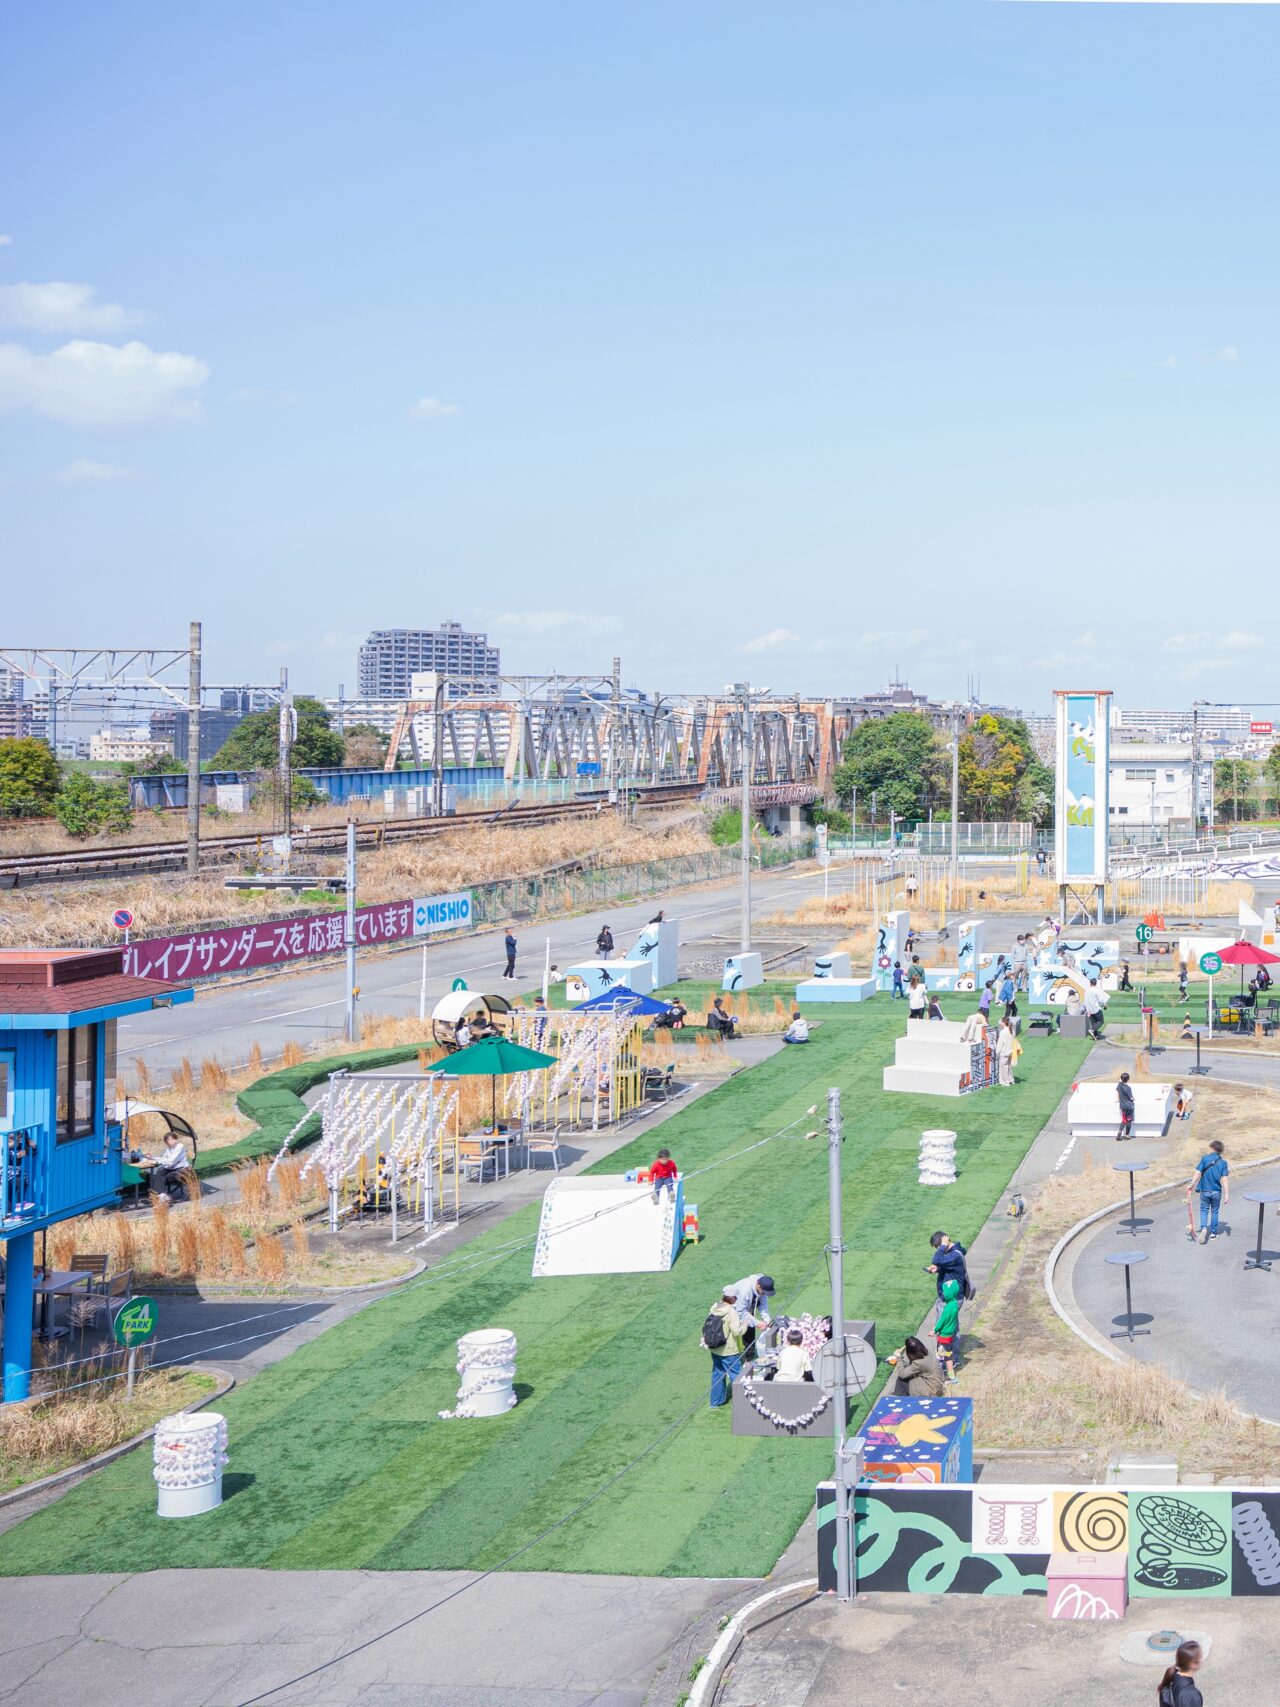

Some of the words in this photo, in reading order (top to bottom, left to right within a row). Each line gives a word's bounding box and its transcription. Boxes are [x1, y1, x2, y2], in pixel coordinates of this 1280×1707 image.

[427, 899, 469, 924] NISHIO
[1138, 926, 1152, 940] 16
[126, 1321, 149, 1329] PARK
